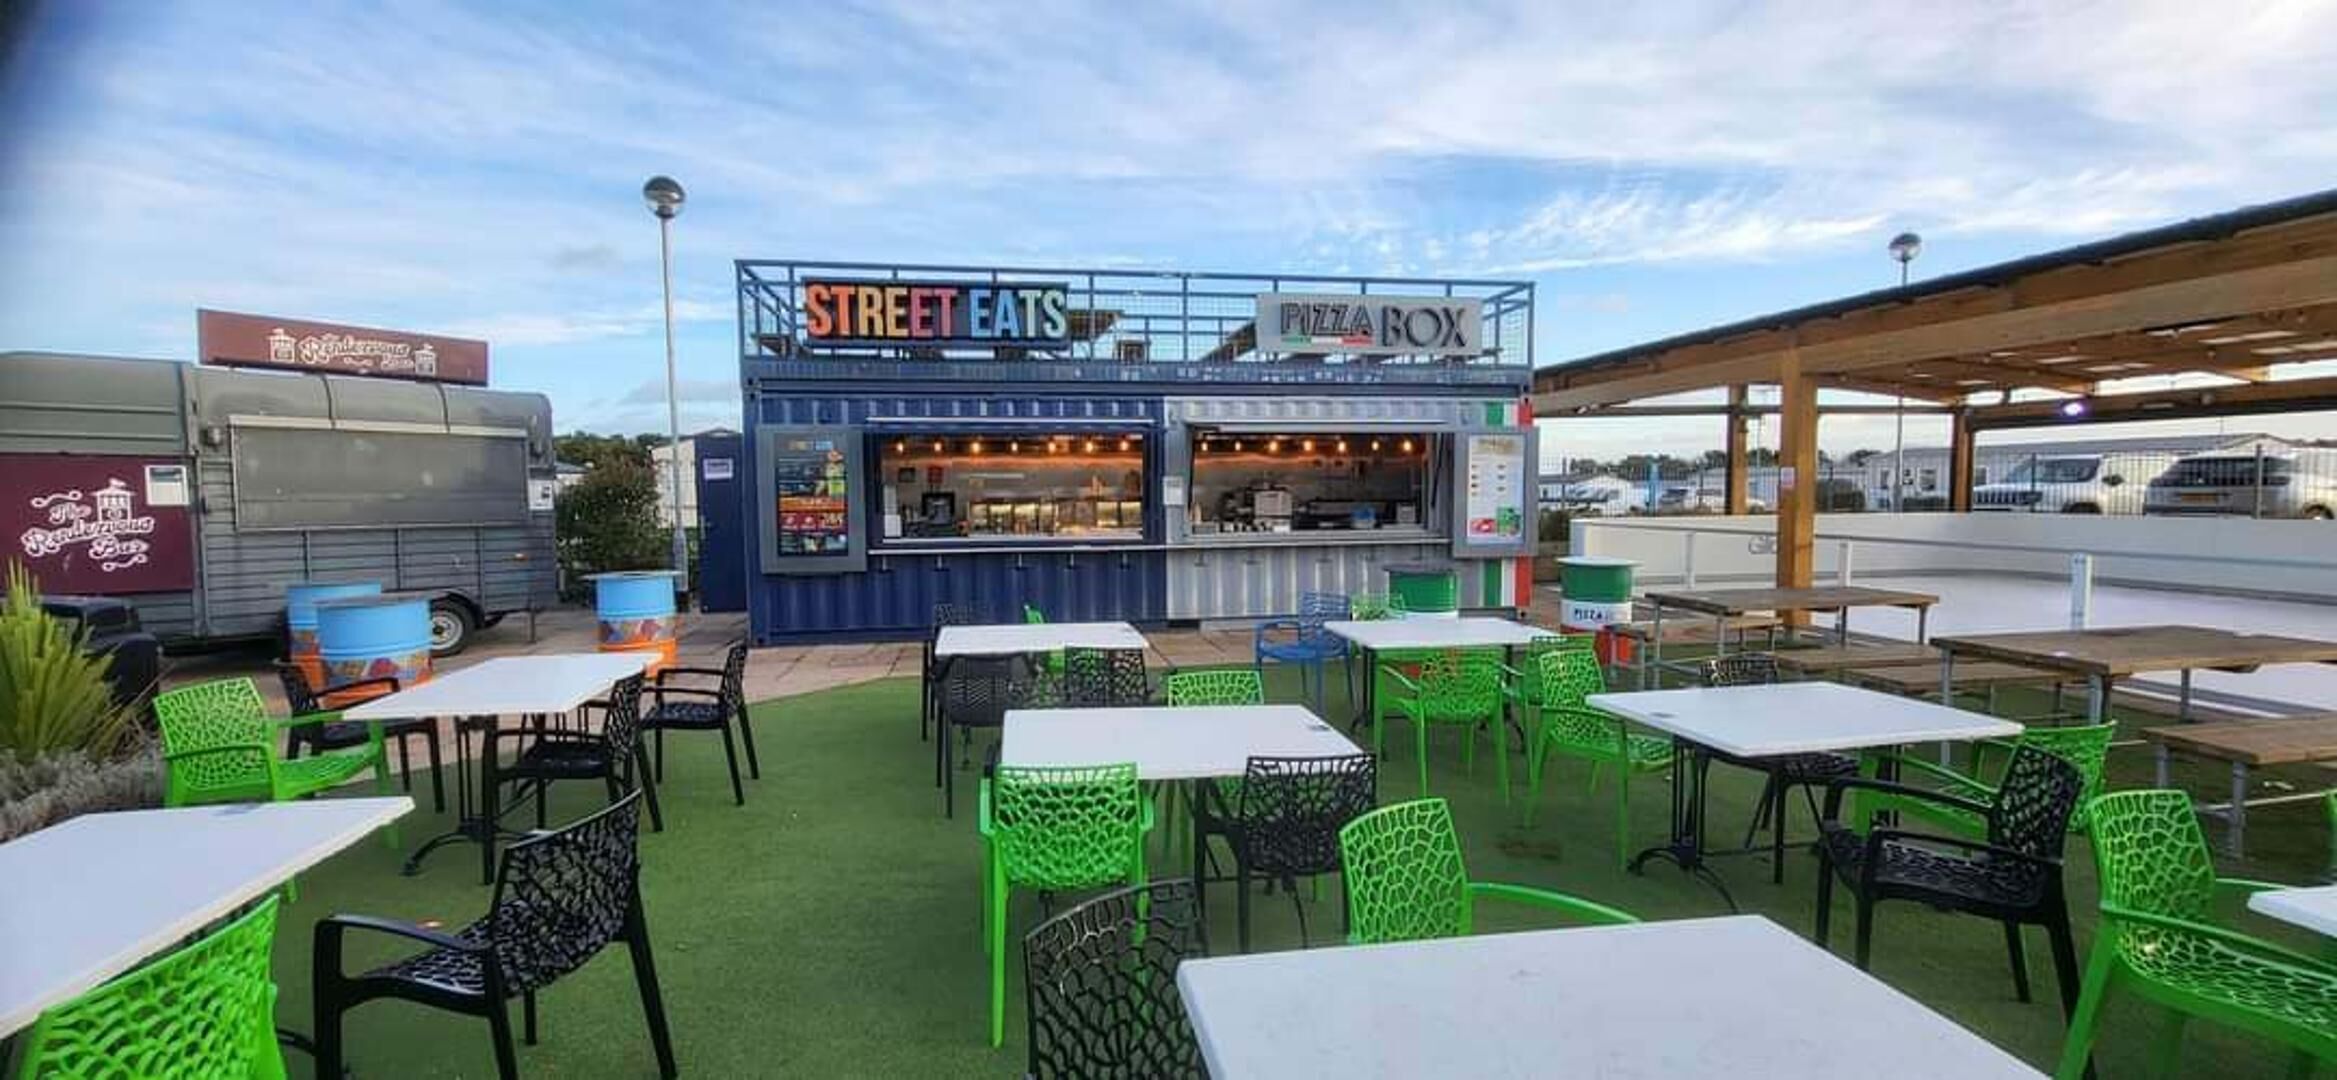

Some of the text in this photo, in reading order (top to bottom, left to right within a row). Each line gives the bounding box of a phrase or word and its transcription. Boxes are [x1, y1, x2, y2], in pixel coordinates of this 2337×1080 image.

[807, 284, 1067, 338] STREET EATS
[1281, 302, 1467, 347] PIZZA BOX
